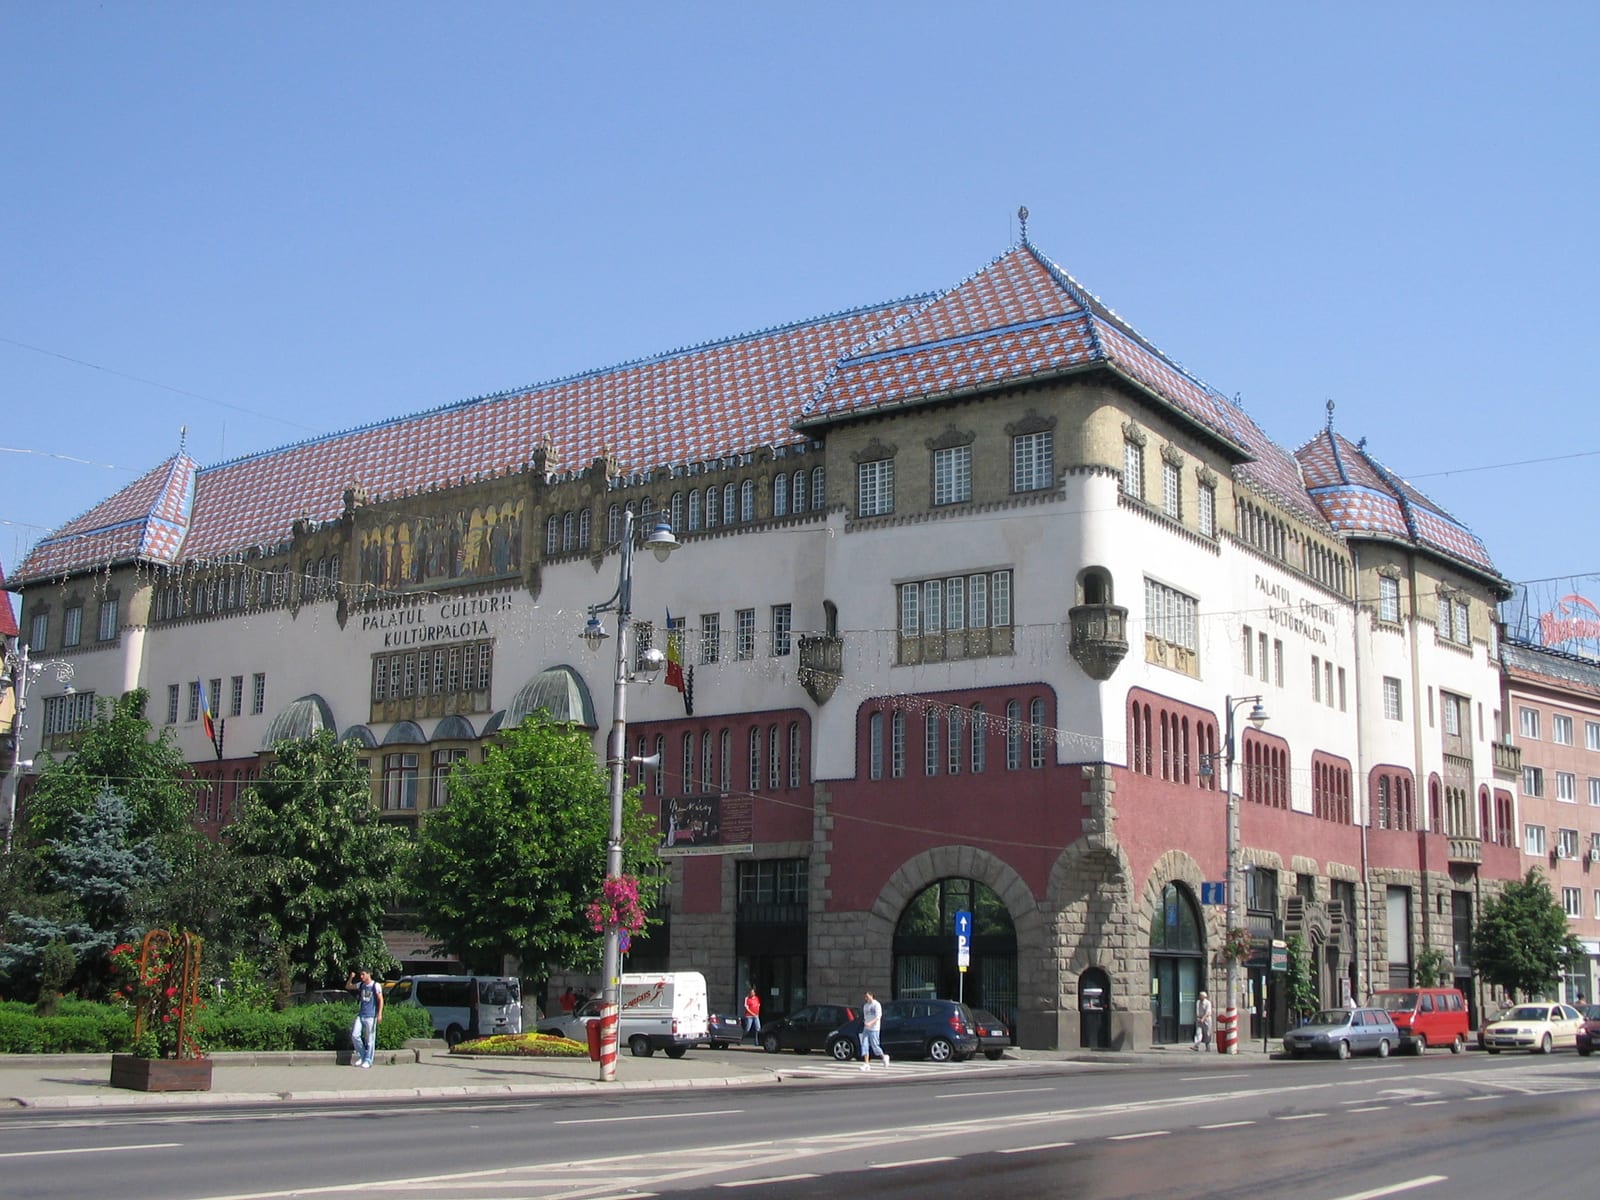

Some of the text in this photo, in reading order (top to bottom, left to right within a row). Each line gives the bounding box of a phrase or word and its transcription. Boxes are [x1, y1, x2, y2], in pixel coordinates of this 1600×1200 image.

[363, 595, 512, 631] PALATUL CULTURII
[1255, 574, 1335, 626] PALATUL CULTURII
